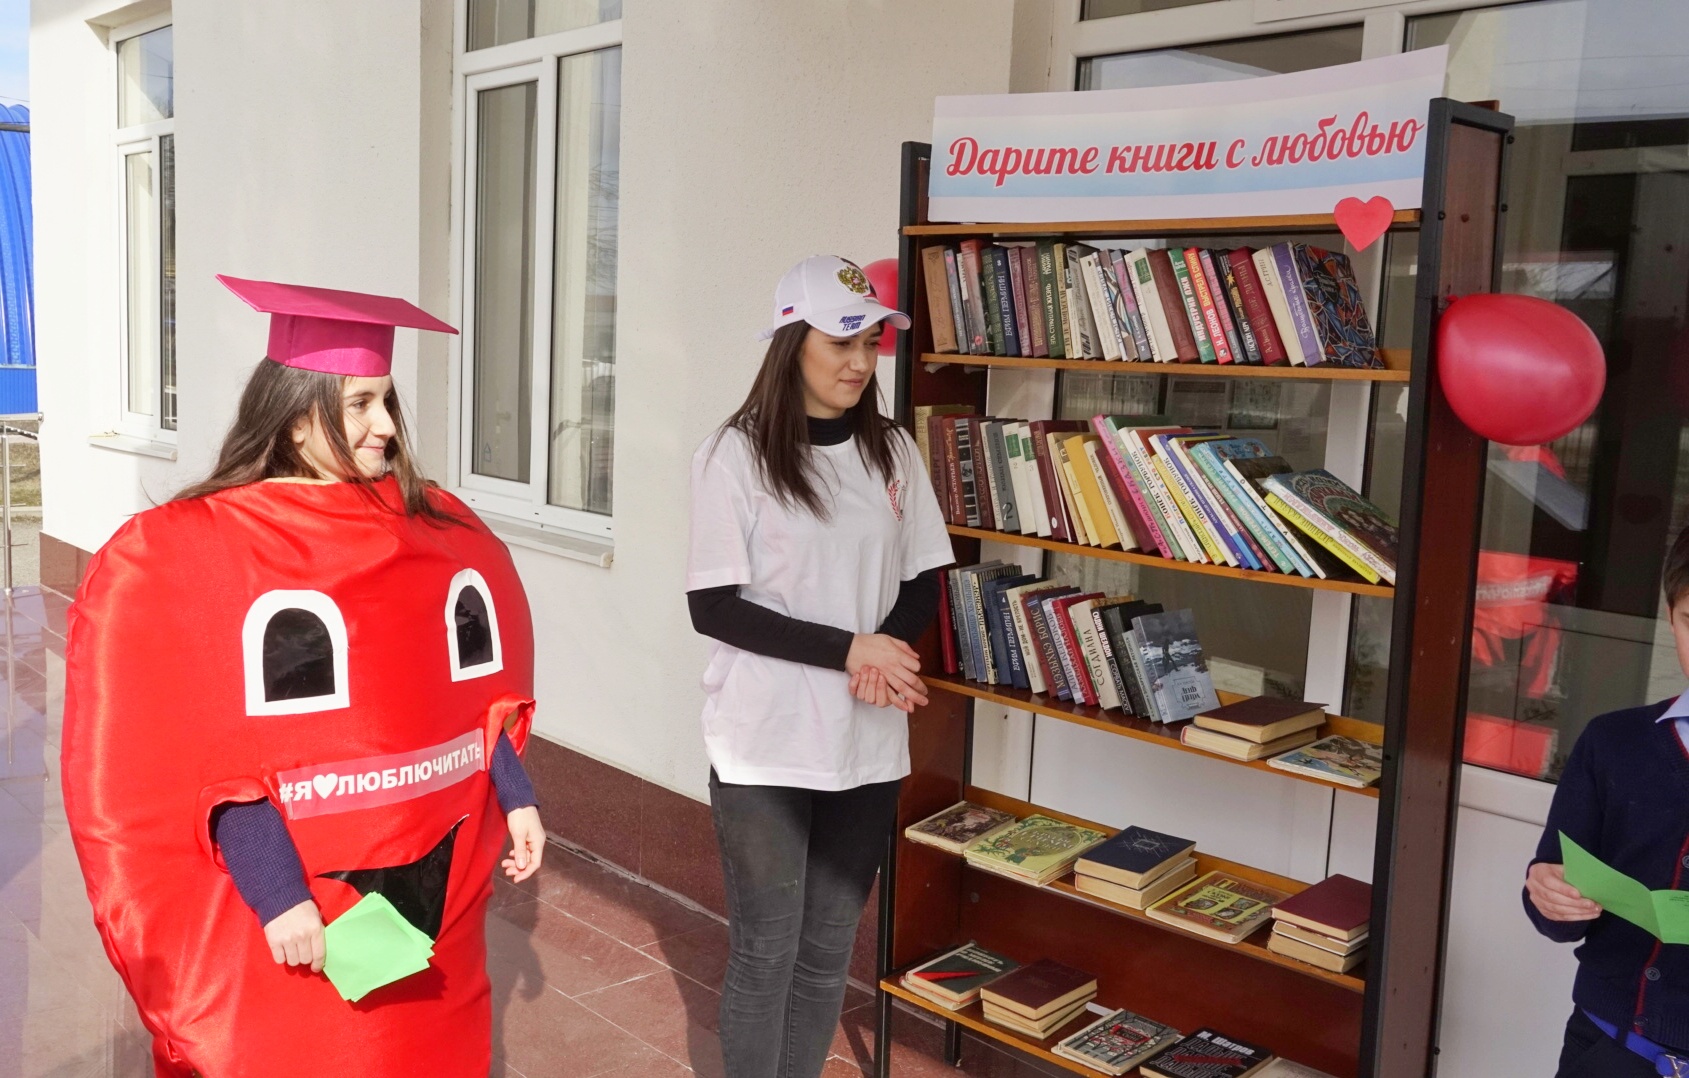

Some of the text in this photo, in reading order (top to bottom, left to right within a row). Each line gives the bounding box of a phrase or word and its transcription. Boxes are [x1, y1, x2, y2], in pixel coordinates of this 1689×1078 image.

[946, 110, 1424, 187] Дарите книги с любовью
[1187, 252, 1200, 273] СПИНУ
[1180, 276, 1192, 295] ЛЖИ
[1195, 278, 1211, 307] ВЫСТРЕЛ
[1186, 297, 1207, 341] ИНДУСТРИЯ
[1206, 308, 1222, 337] ЛЕОНОВ
[1216, 337, 1224, 346] Н.
[1151, 468, 1161, 481] СТО
[1030, 607, 1066, 689] МЭЗЫХЬЭ БОРИС
[1046, 613, 1078, 691] АЛИМ КЕШОКОВ
[1082, 628, 1106, 686] СОГДИАНА
